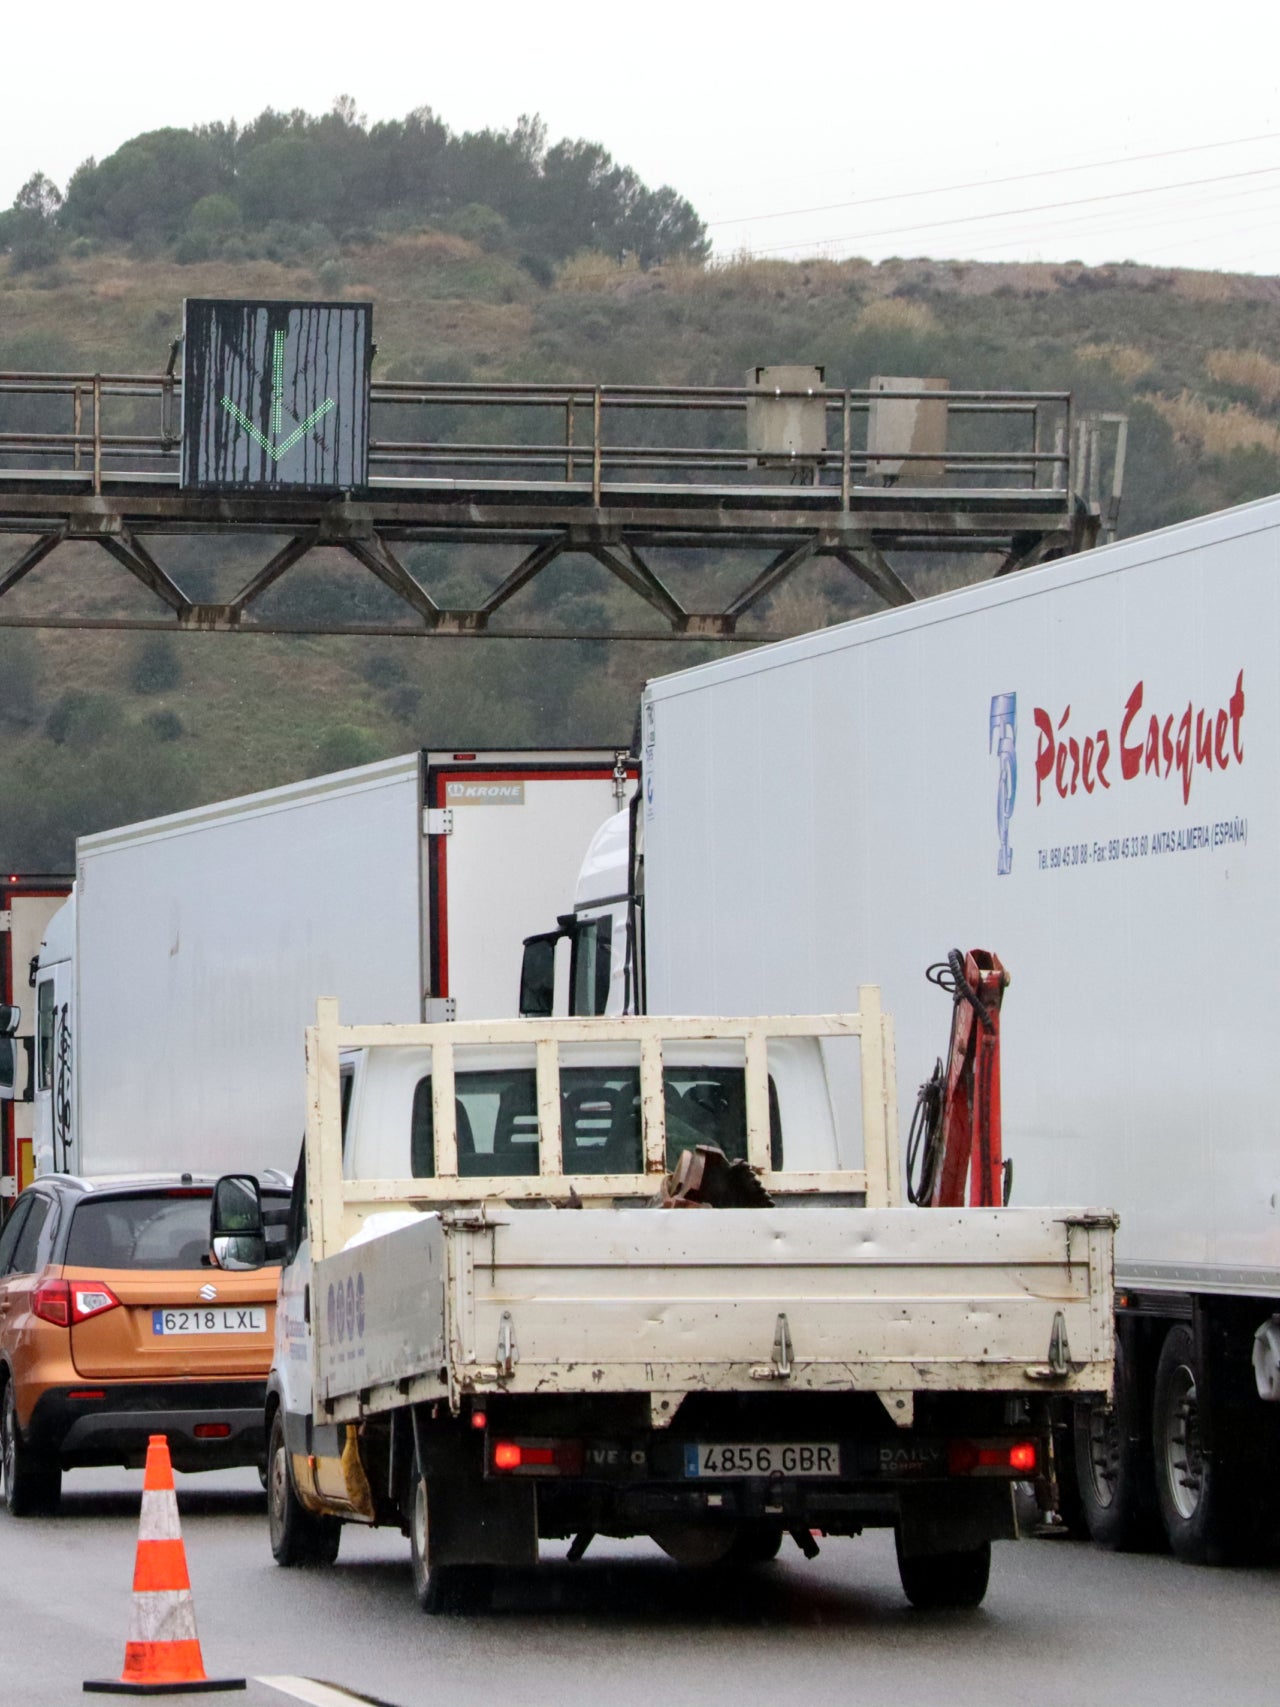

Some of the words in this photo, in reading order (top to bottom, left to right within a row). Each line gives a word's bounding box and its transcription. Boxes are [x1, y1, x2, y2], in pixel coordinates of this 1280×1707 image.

[1033, 703, 1111, 808] Pérez
[1120, 668, 1245, 807] Casquet
[465, 786, 521, 797] KRONE
[1151, 830, 1175, 855] ANTAS
[1176, 825, 1210, 852] ALMERIA
[1210, 815, 1248, 853] (ESPAÑA)
[165, 1311, 216, 1332] 6218
[223, 1310, 260, 1330] LXL
[703, 1447, 771, 1472] 4856
[781, 1446, 832, 1472] GBR
